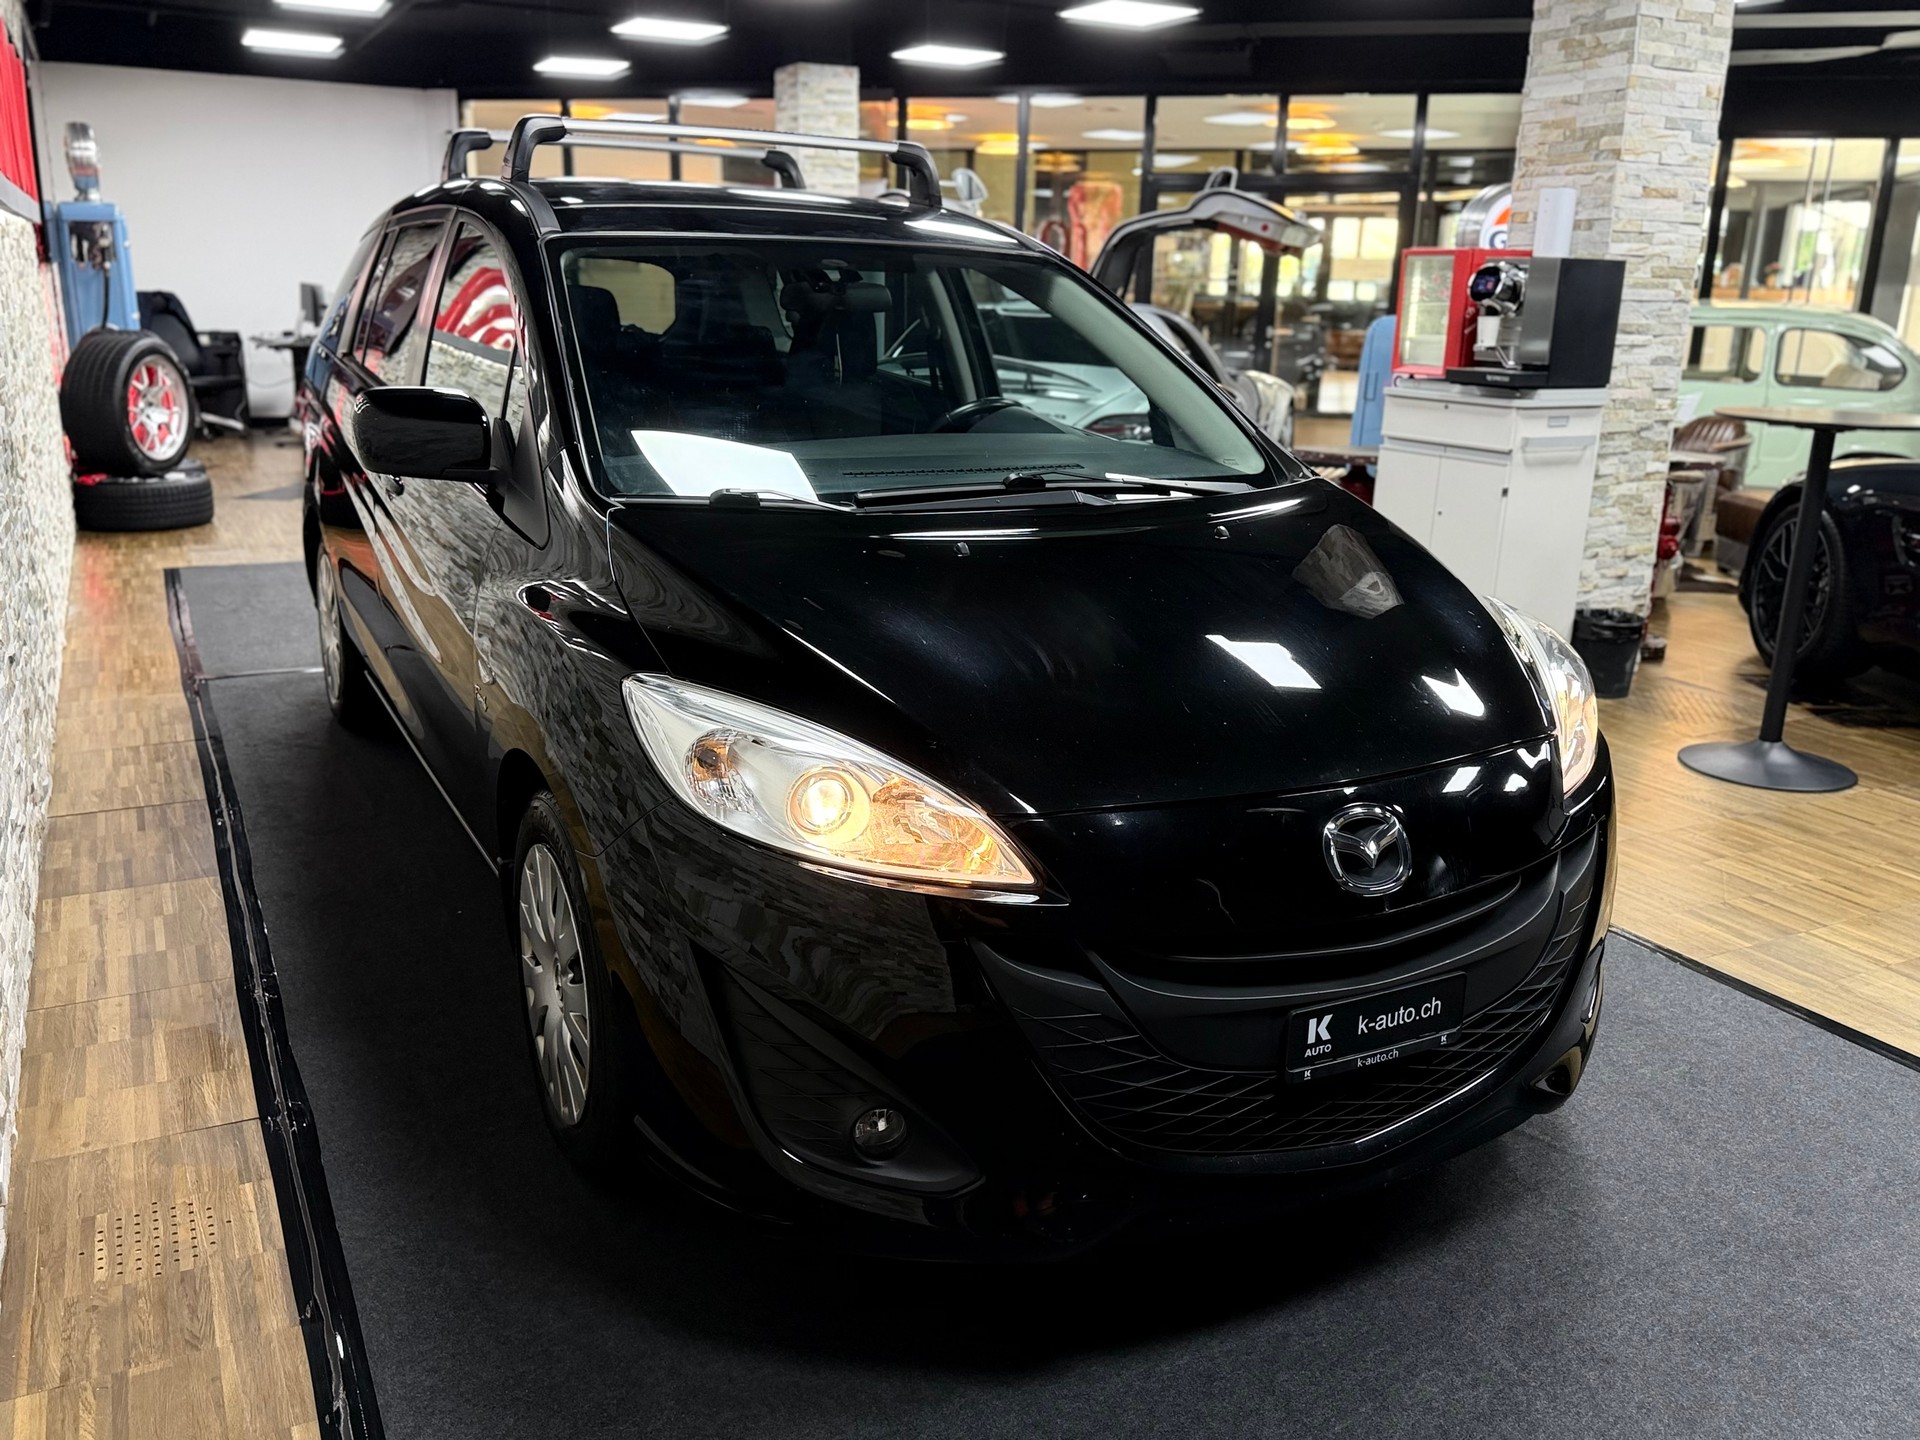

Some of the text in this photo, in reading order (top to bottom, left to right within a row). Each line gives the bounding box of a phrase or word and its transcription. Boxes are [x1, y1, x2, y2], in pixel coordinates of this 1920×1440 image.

[1357, 997, 1442, 1035] k-auto.ch
[1307, 1014, 1333, 1044] K
[1304, 1044, 1332, 1058] AUTO
[1357, 1049, 1399, 1067] k-auto.ch
